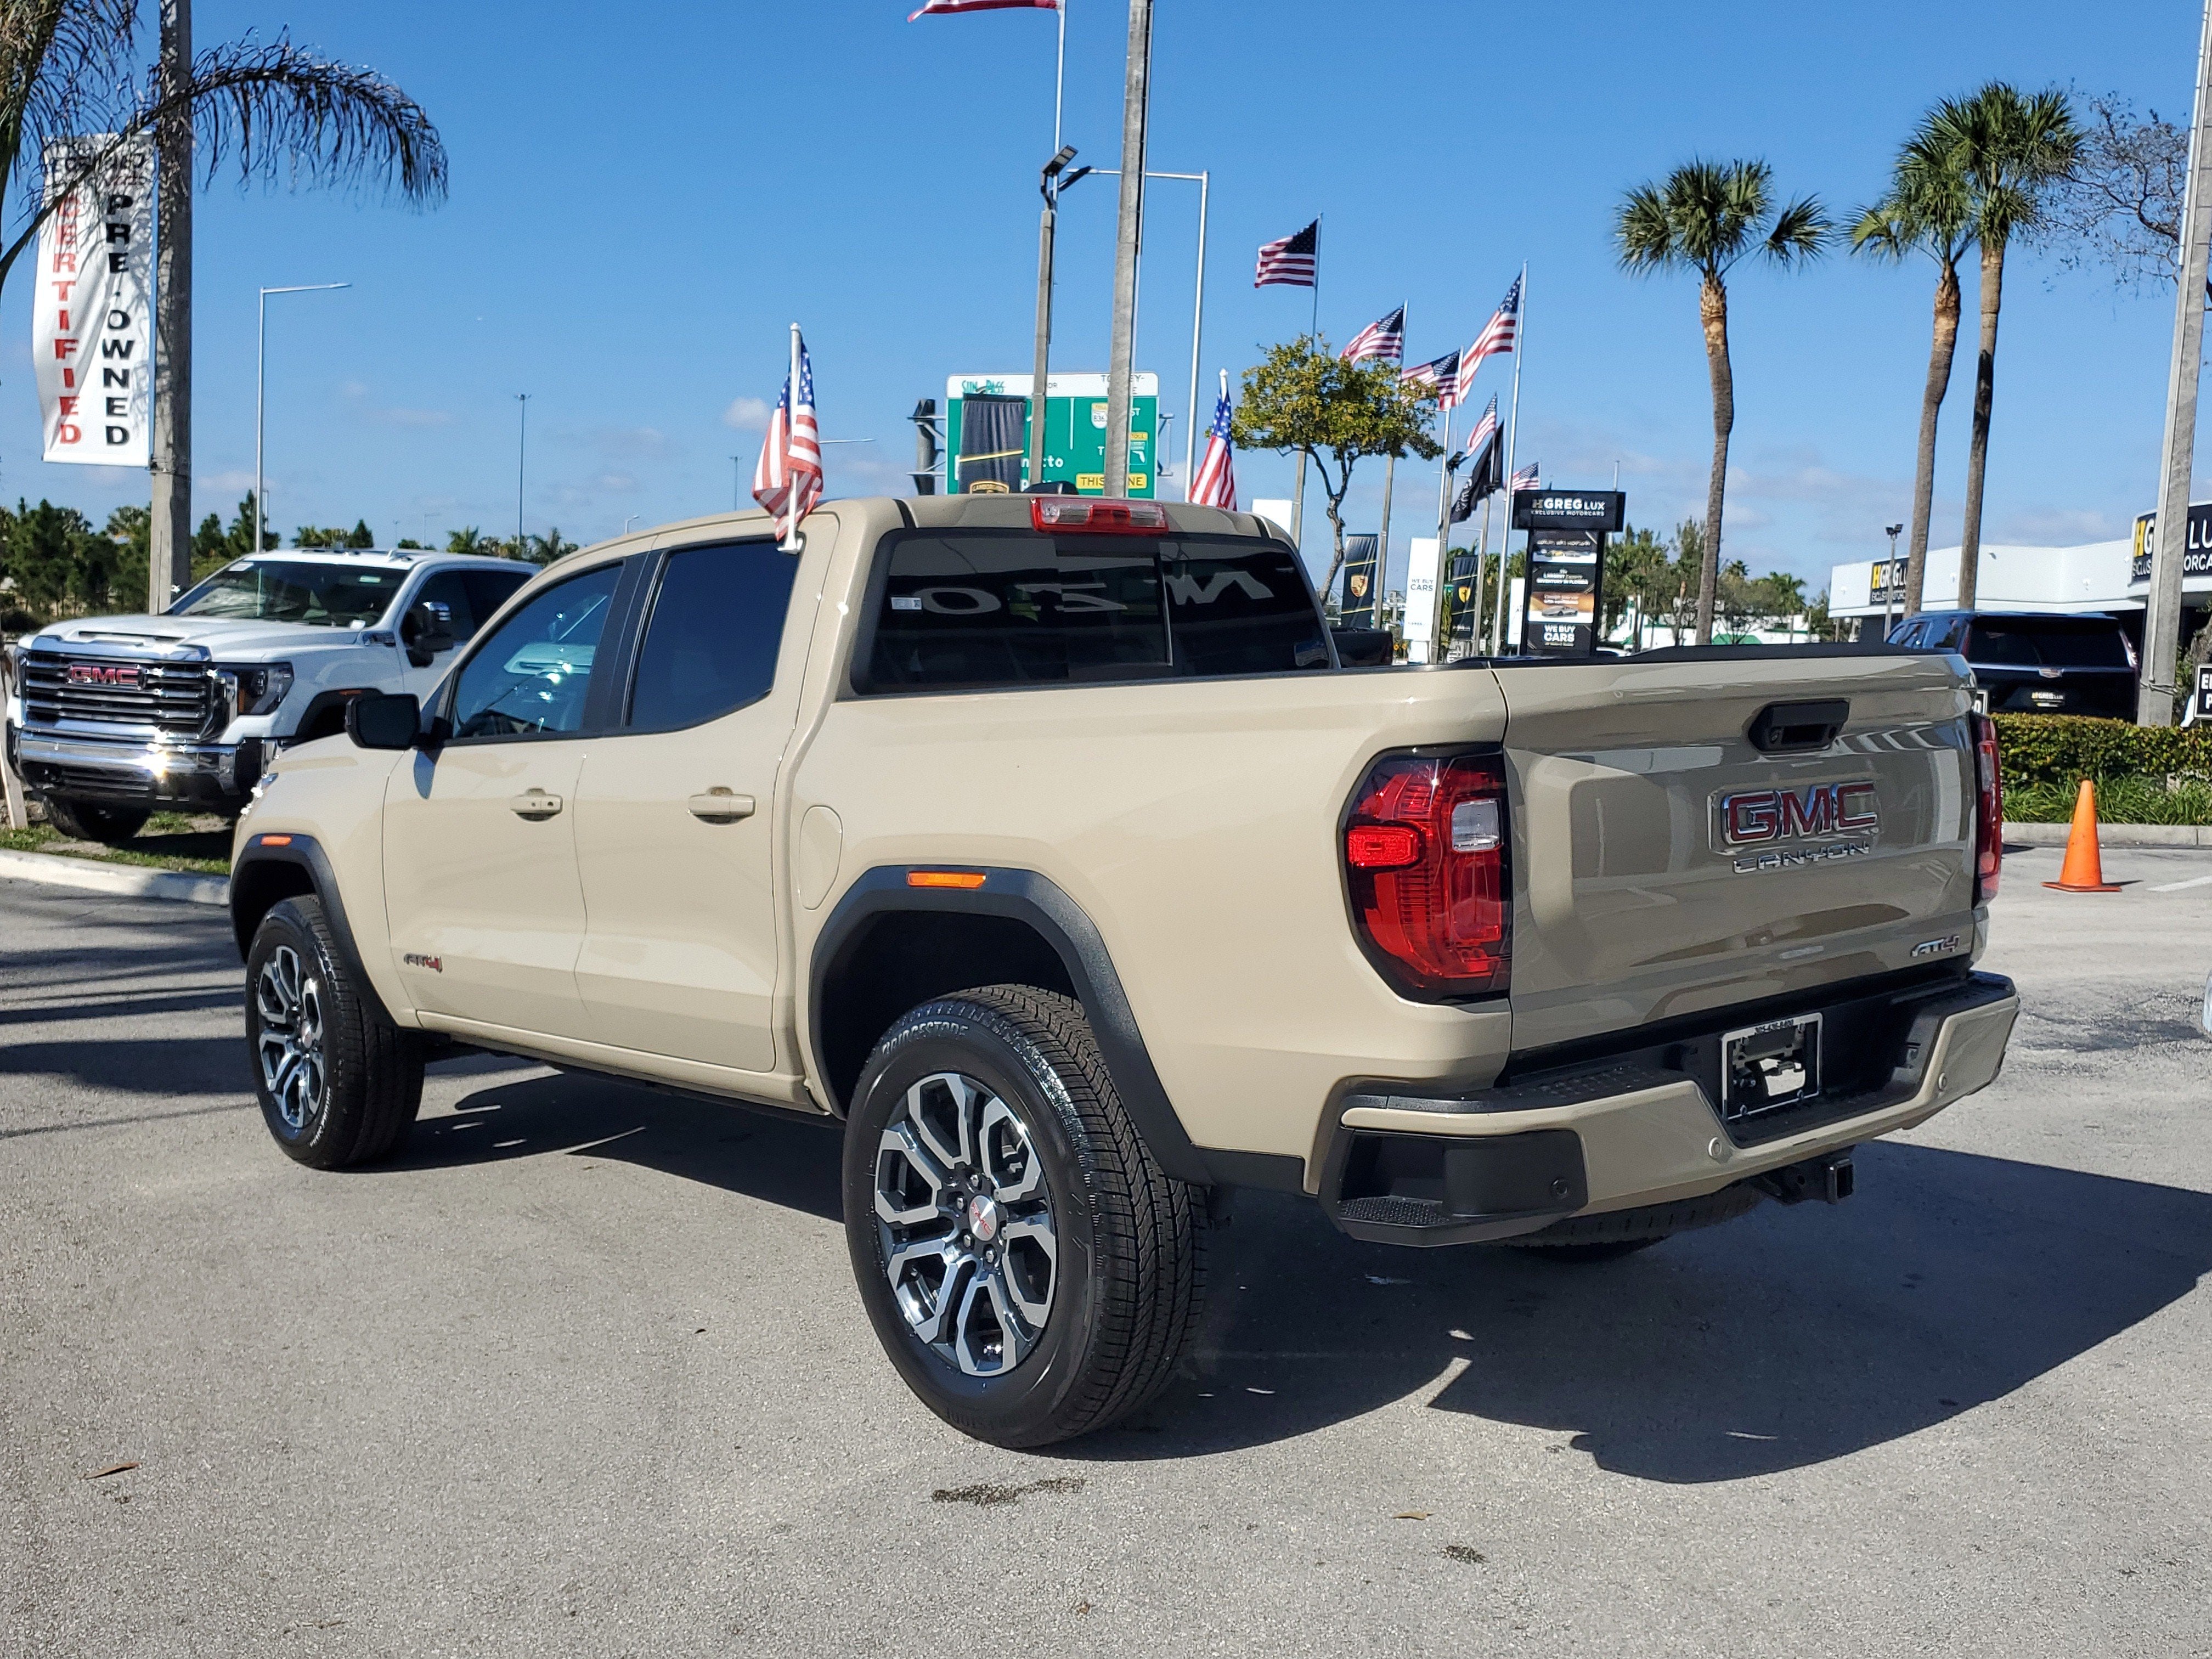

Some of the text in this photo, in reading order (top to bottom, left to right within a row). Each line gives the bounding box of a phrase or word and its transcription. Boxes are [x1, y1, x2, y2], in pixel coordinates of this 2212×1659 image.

[52, 195, 82, 445] CERTIFIED
[1128, 477, 1143, 486] NE
[1532, 498, 1605, 510] HGREG LUX
[2189, 518, 2212, 549] LU
[1544, 633, 1575, 642] CARS
[71, 665, 138, 685] GMC
[1722, 780, 1877, 845] GMC
[1733, 841, 1870, 874] CANYON
[1910, 935, 1960, 957] AT4
